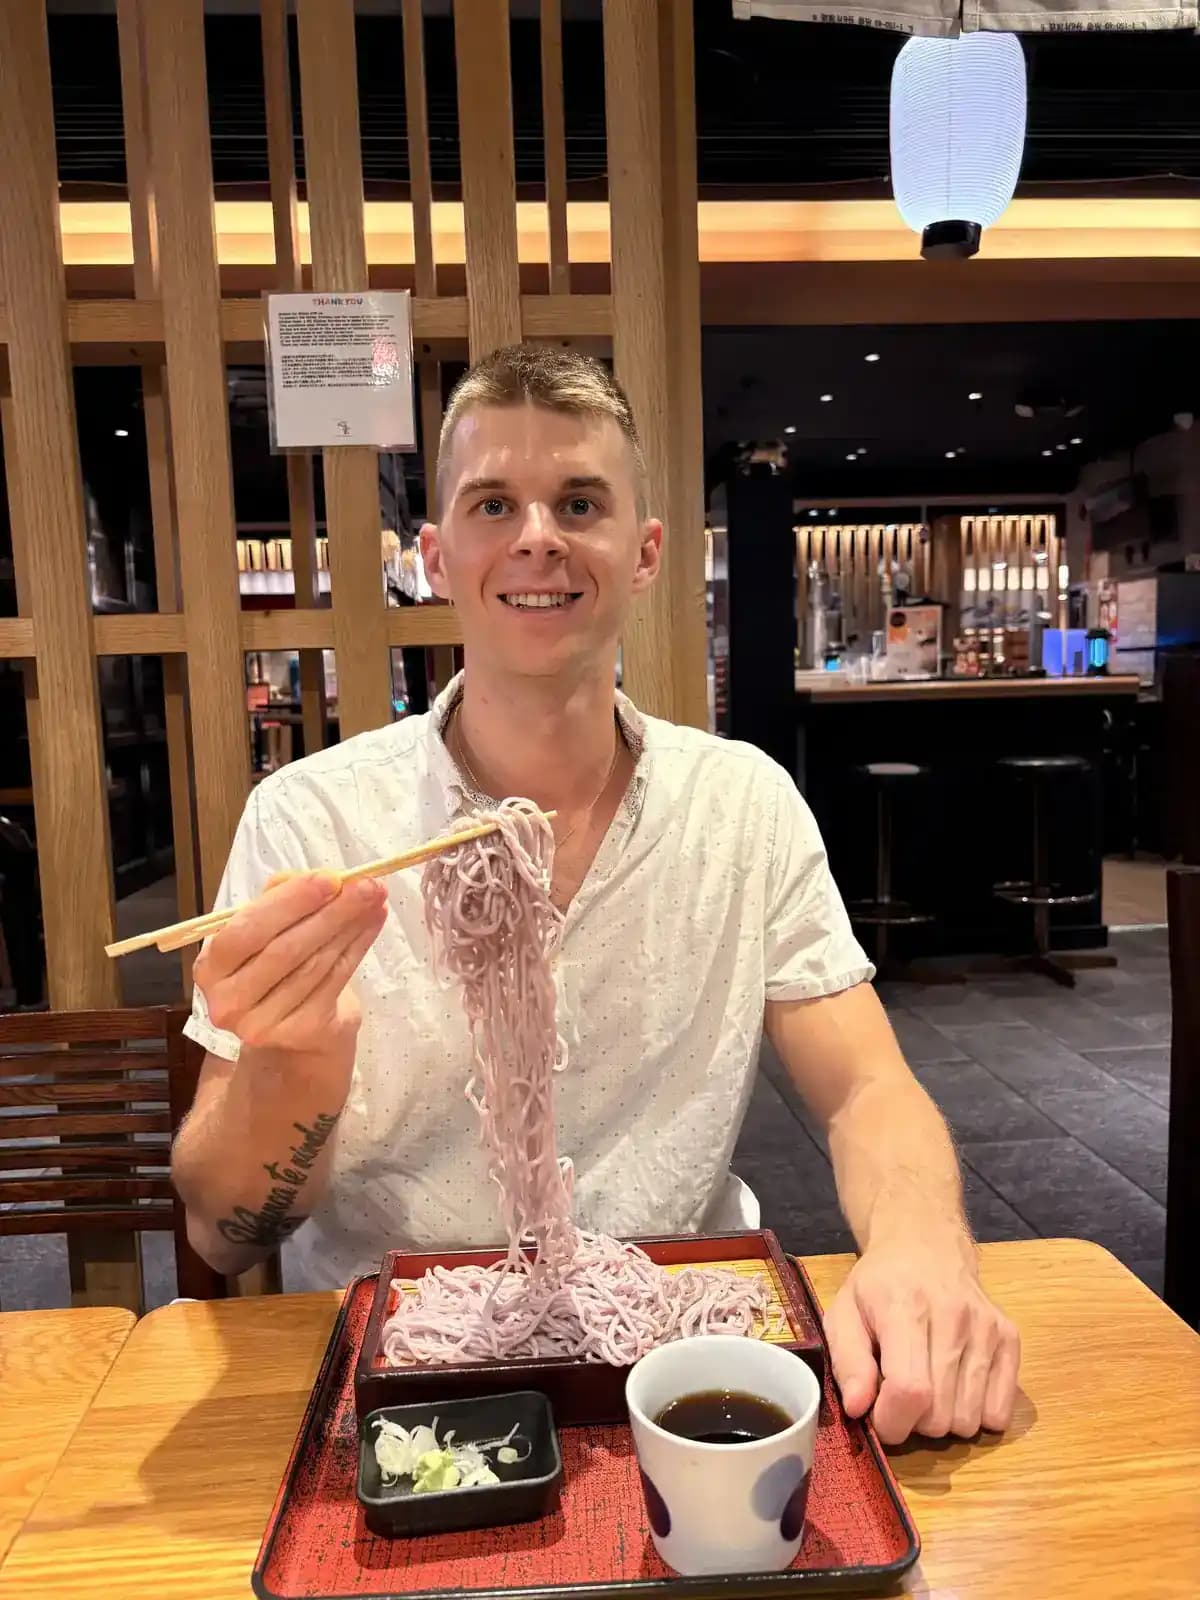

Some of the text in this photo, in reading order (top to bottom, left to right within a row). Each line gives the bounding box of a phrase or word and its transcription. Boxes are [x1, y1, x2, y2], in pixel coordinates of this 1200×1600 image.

[312, 297, 363, 305] THANK YOU
[262, 1161, 309, 1186] te
